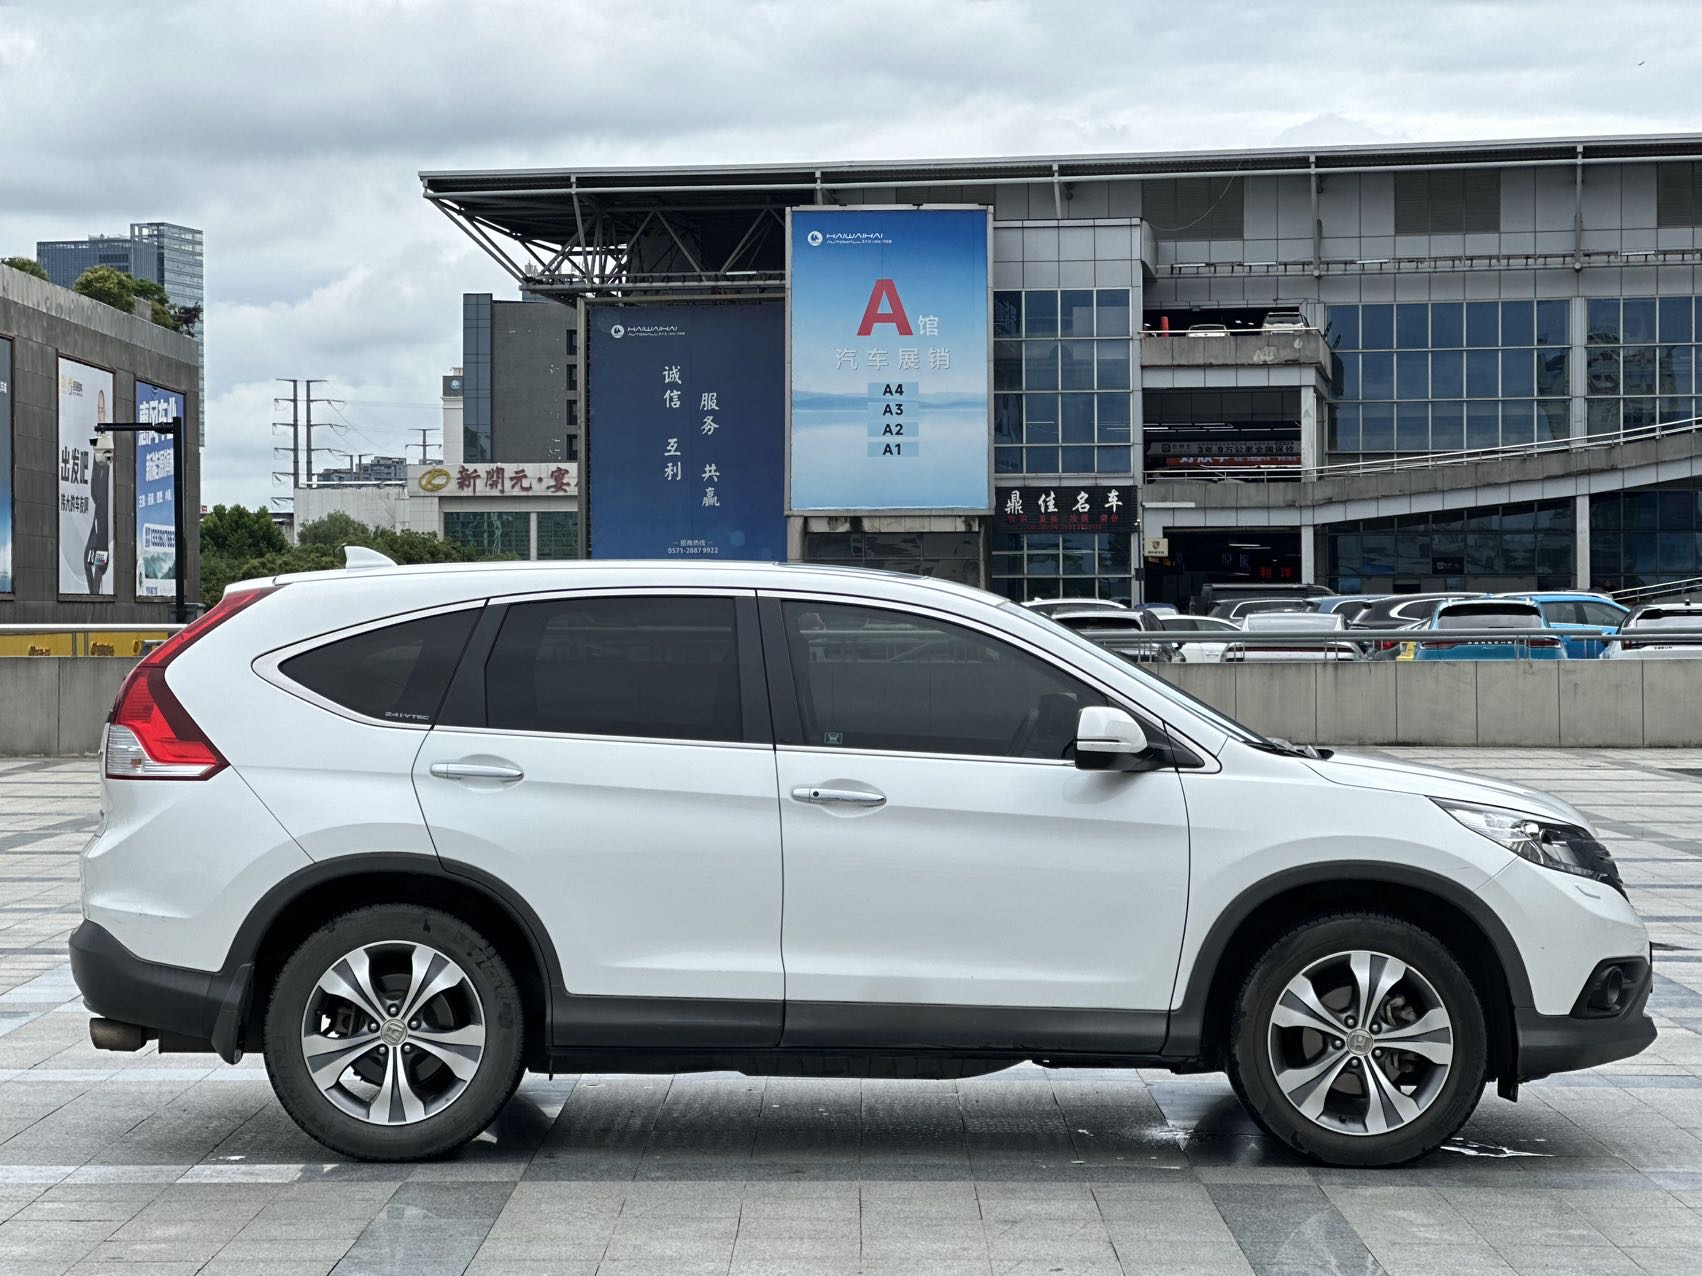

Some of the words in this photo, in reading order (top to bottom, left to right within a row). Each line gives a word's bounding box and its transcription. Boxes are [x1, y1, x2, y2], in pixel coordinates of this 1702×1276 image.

[835, 348, 951, 370] 汽车展销
[662, 365, 682, 409] 诚信
[882, 384, 904, 396] A4
[700, 392, 720, 435] 服务
[882, 404, 904, 416] A3
[882, 424, 904, 436] A2
[664, 438, 682, 481] 互利
[882, 444, 902, 456] A1
[60, 446, 88, 485] 出发吧
[701, 463, 720, 507] 共赢
[1004, 488, 1123, 515] 鼎佳名车
